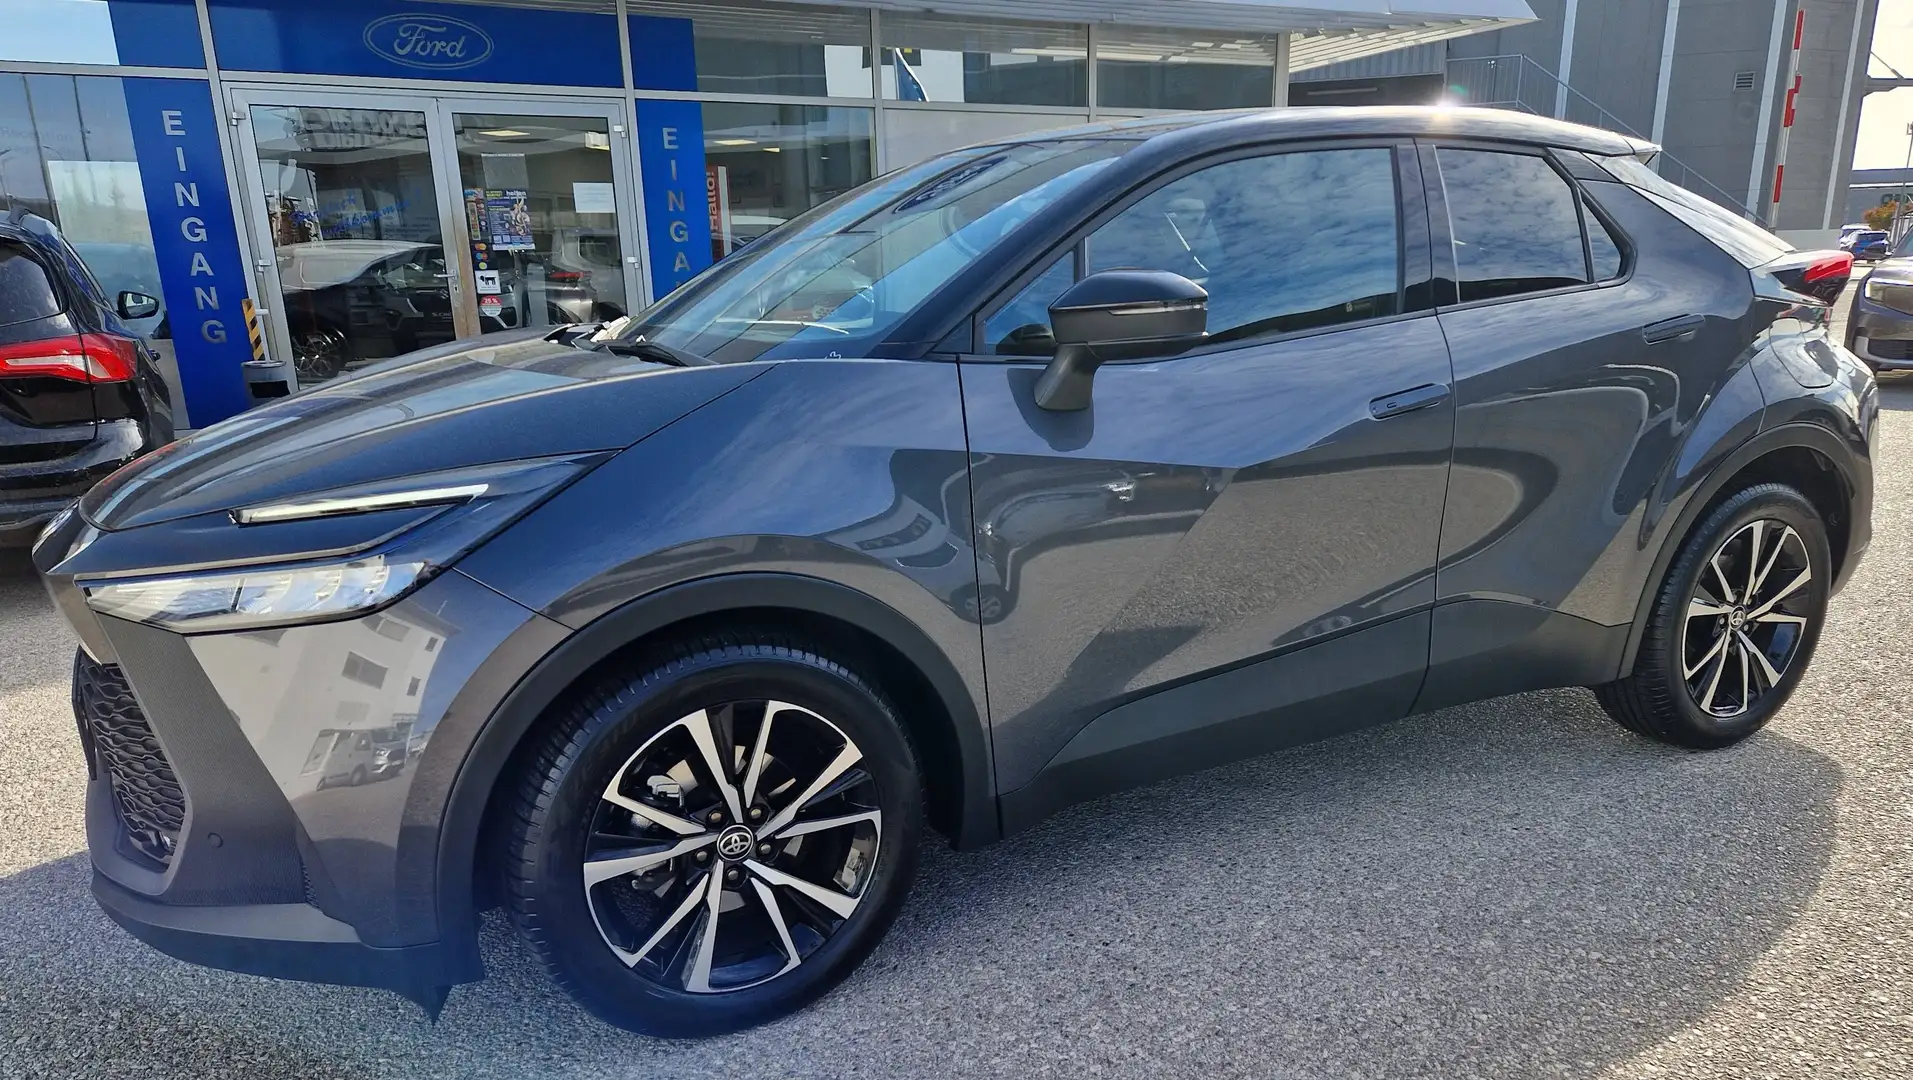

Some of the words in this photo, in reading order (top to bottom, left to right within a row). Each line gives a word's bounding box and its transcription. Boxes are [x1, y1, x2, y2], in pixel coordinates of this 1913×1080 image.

[393, 23, 467, 58] Ford
[162, 110, 227, 343] EINGANG
[662, 127, 692, 291] EINGA
